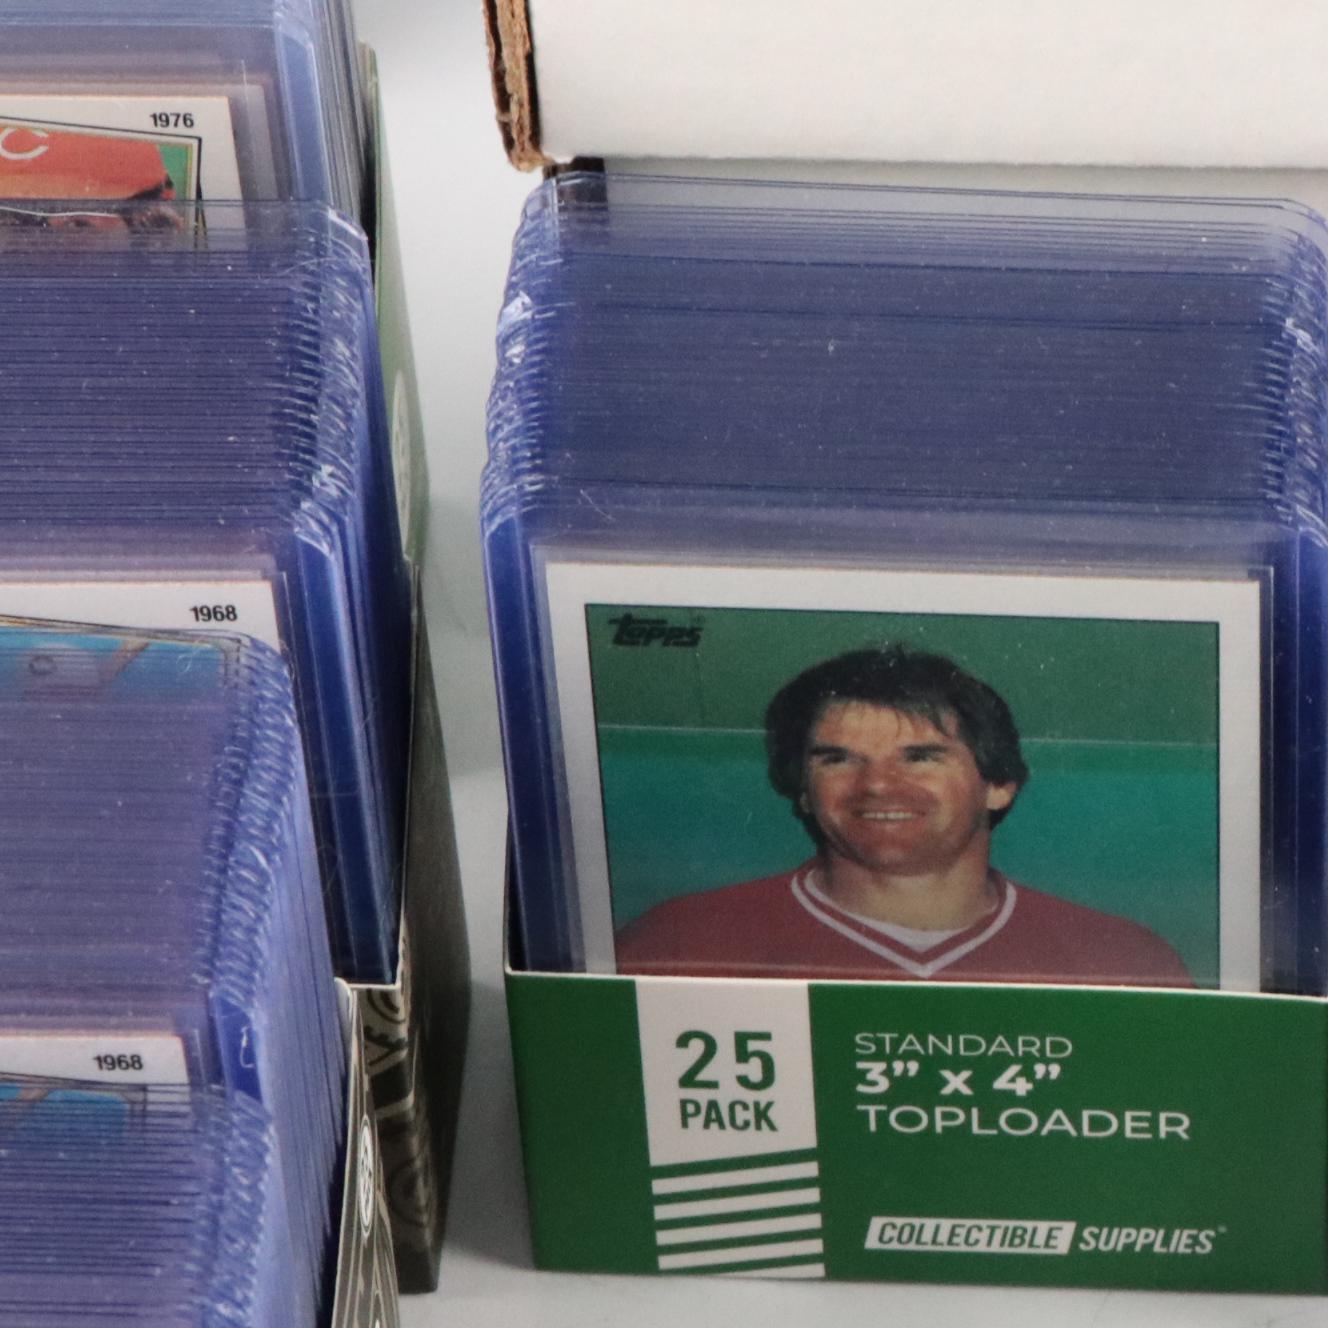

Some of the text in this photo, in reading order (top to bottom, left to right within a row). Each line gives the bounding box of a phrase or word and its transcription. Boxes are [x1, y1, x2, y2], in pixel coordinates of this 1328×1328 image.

[150, 113, 194, 128] 1976
[189, 604, 238, 623] 1968
[854, 1032, 1073, 1058] STANDARD
[93, 1054, 144, 1071] 1968
[674, 1030, 776, 1092] 25
[679, 1098, 778, 1133] PACK
[856, 1104, 1191, 1141] TOPLOADER
[877, 1222, 1064, 1251] COLLECTIBLE
